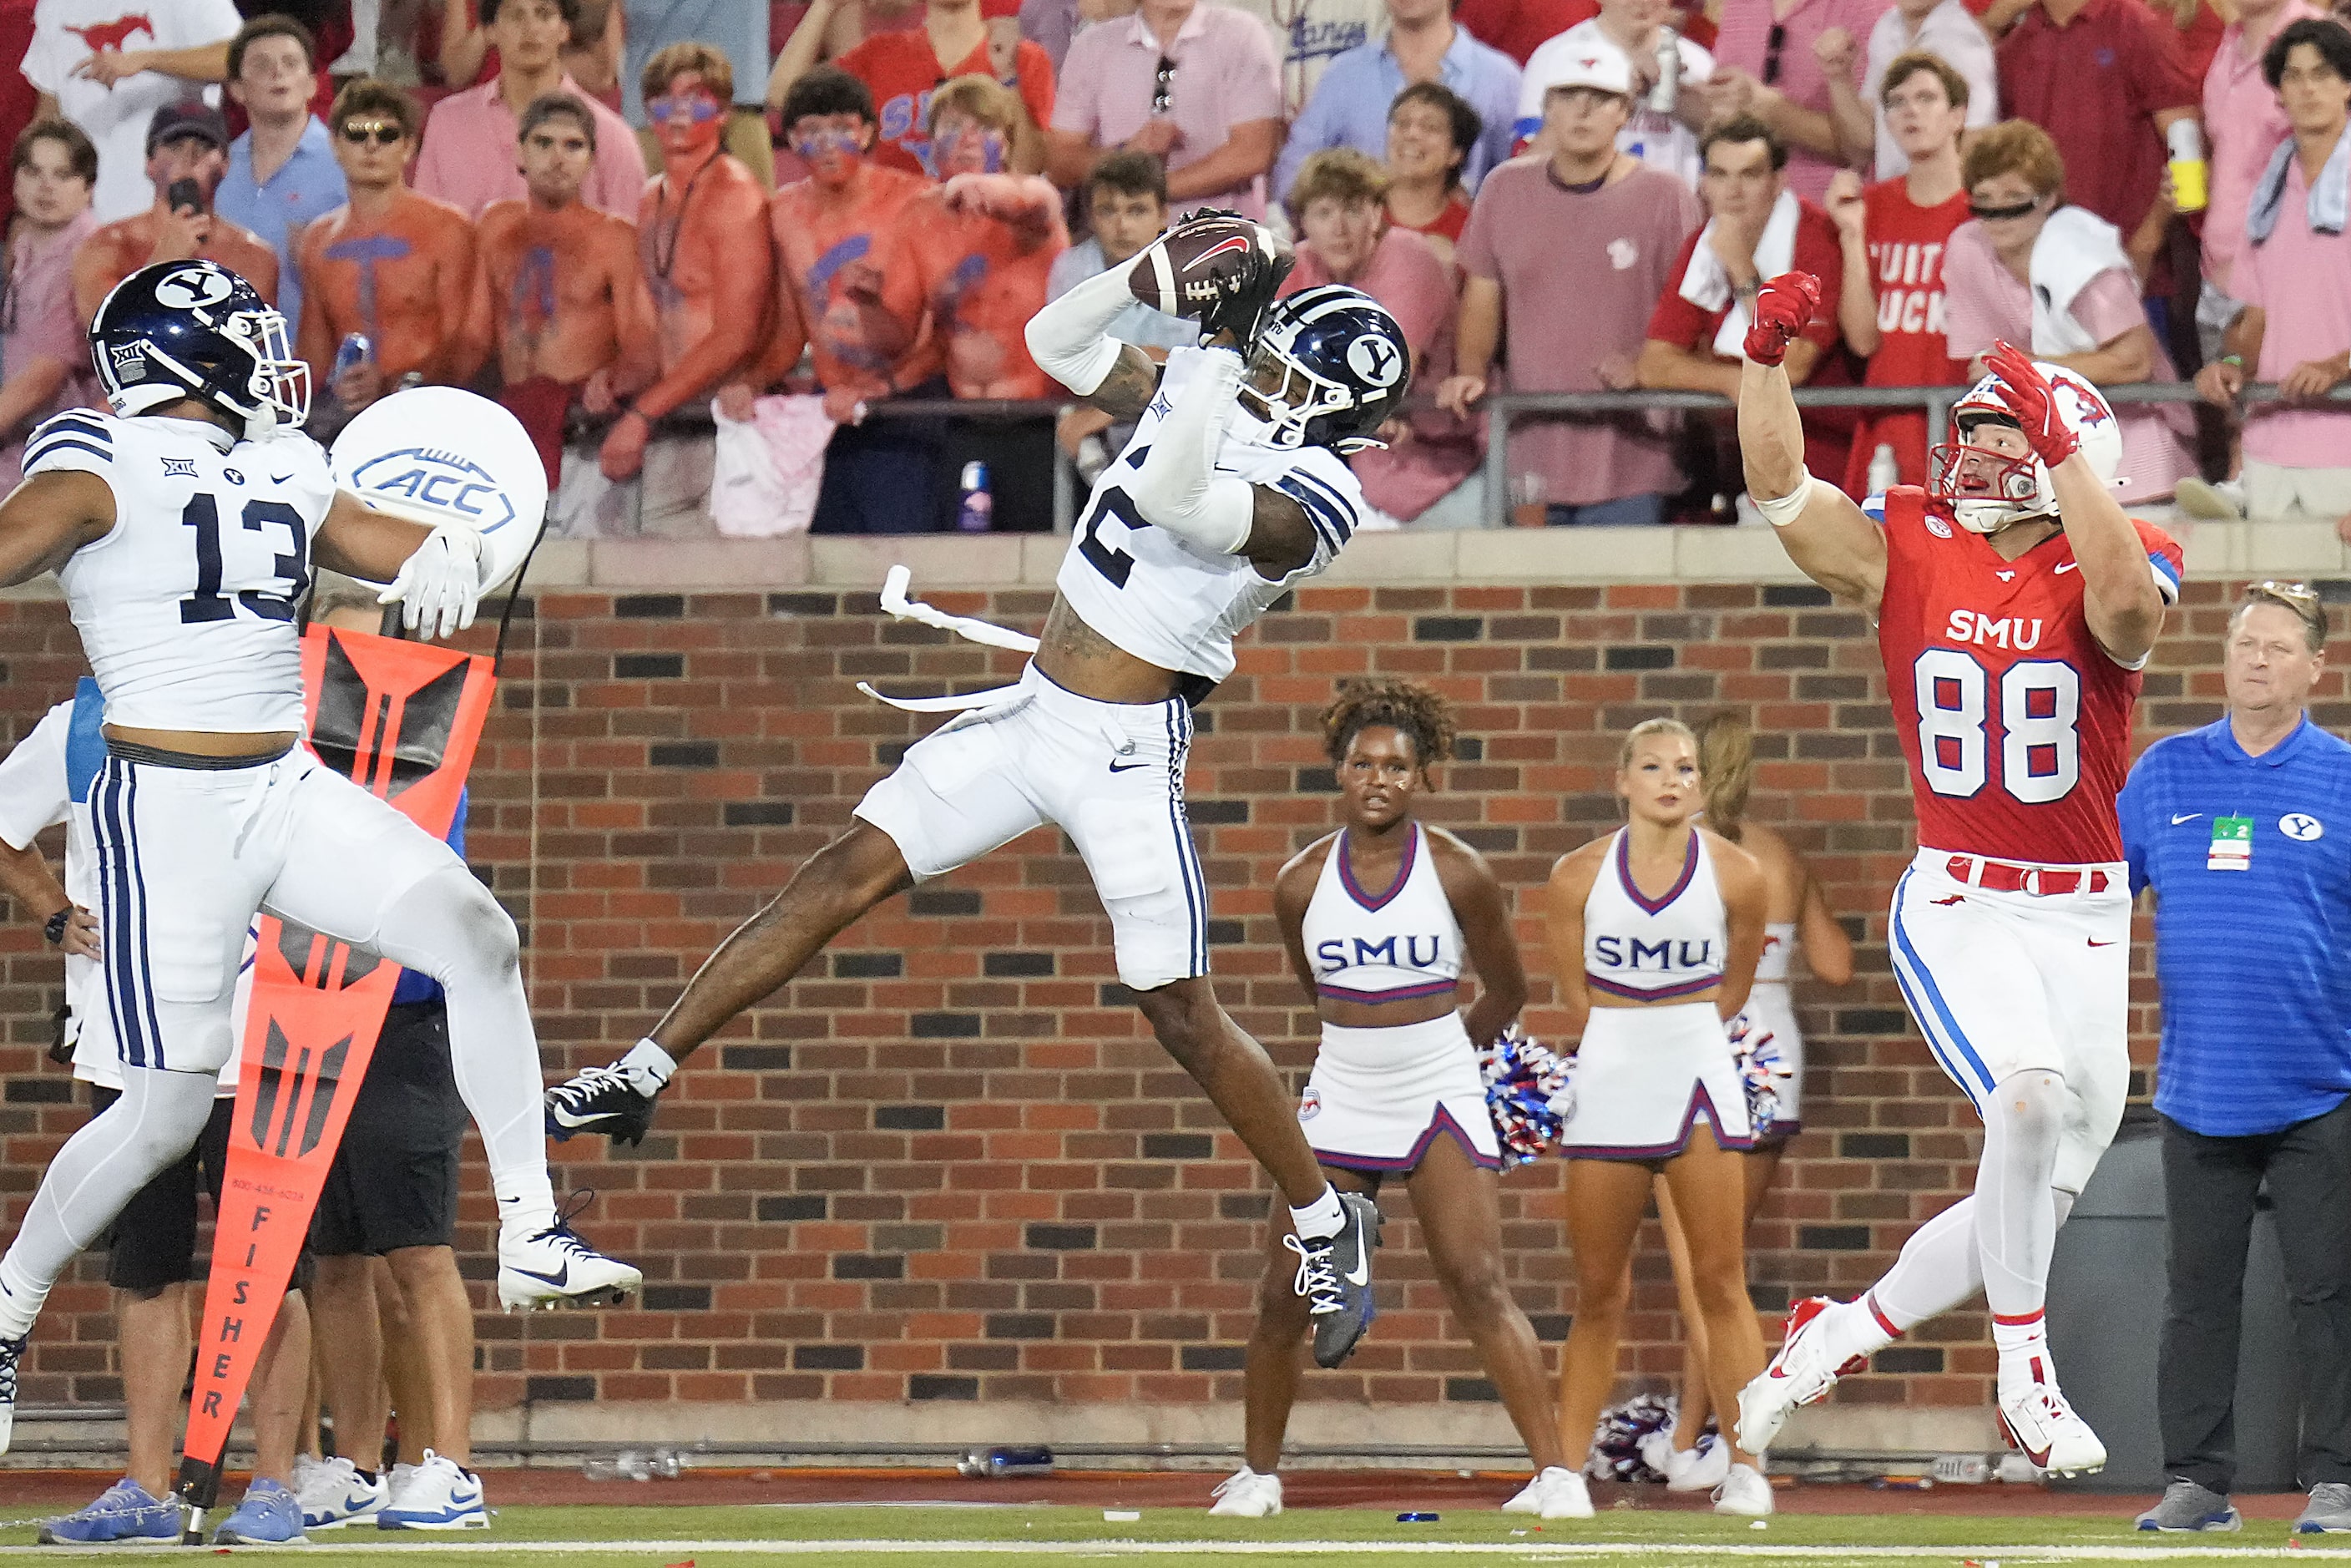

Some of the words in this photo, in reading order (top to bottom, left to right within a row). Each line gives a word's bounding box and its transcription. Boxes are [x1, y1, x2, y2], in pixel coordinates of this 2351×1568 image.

[1869, 241, 1944, 284] UIT
[163, 271, 215, 302] Y
[1268, 320, 1284, 336] YU
[1877, 290, 1949, 335] UCK
[1358, 338, 1398, 382] Y
[372, 468, 498, 515] ACC
[179, 492, 310, 625] 13
[1945, 609, 2044, 651] SMU
[1913, 645, 2083, 806] 88
[2235, 825, 2249, 839] 2
[2288, 817, 2315, 837] Y
[1317, 934, 1441, 972] SMU
[1595, 935, 1711, 969] SMU
[201, 1205, 271, 1419] FISHER
